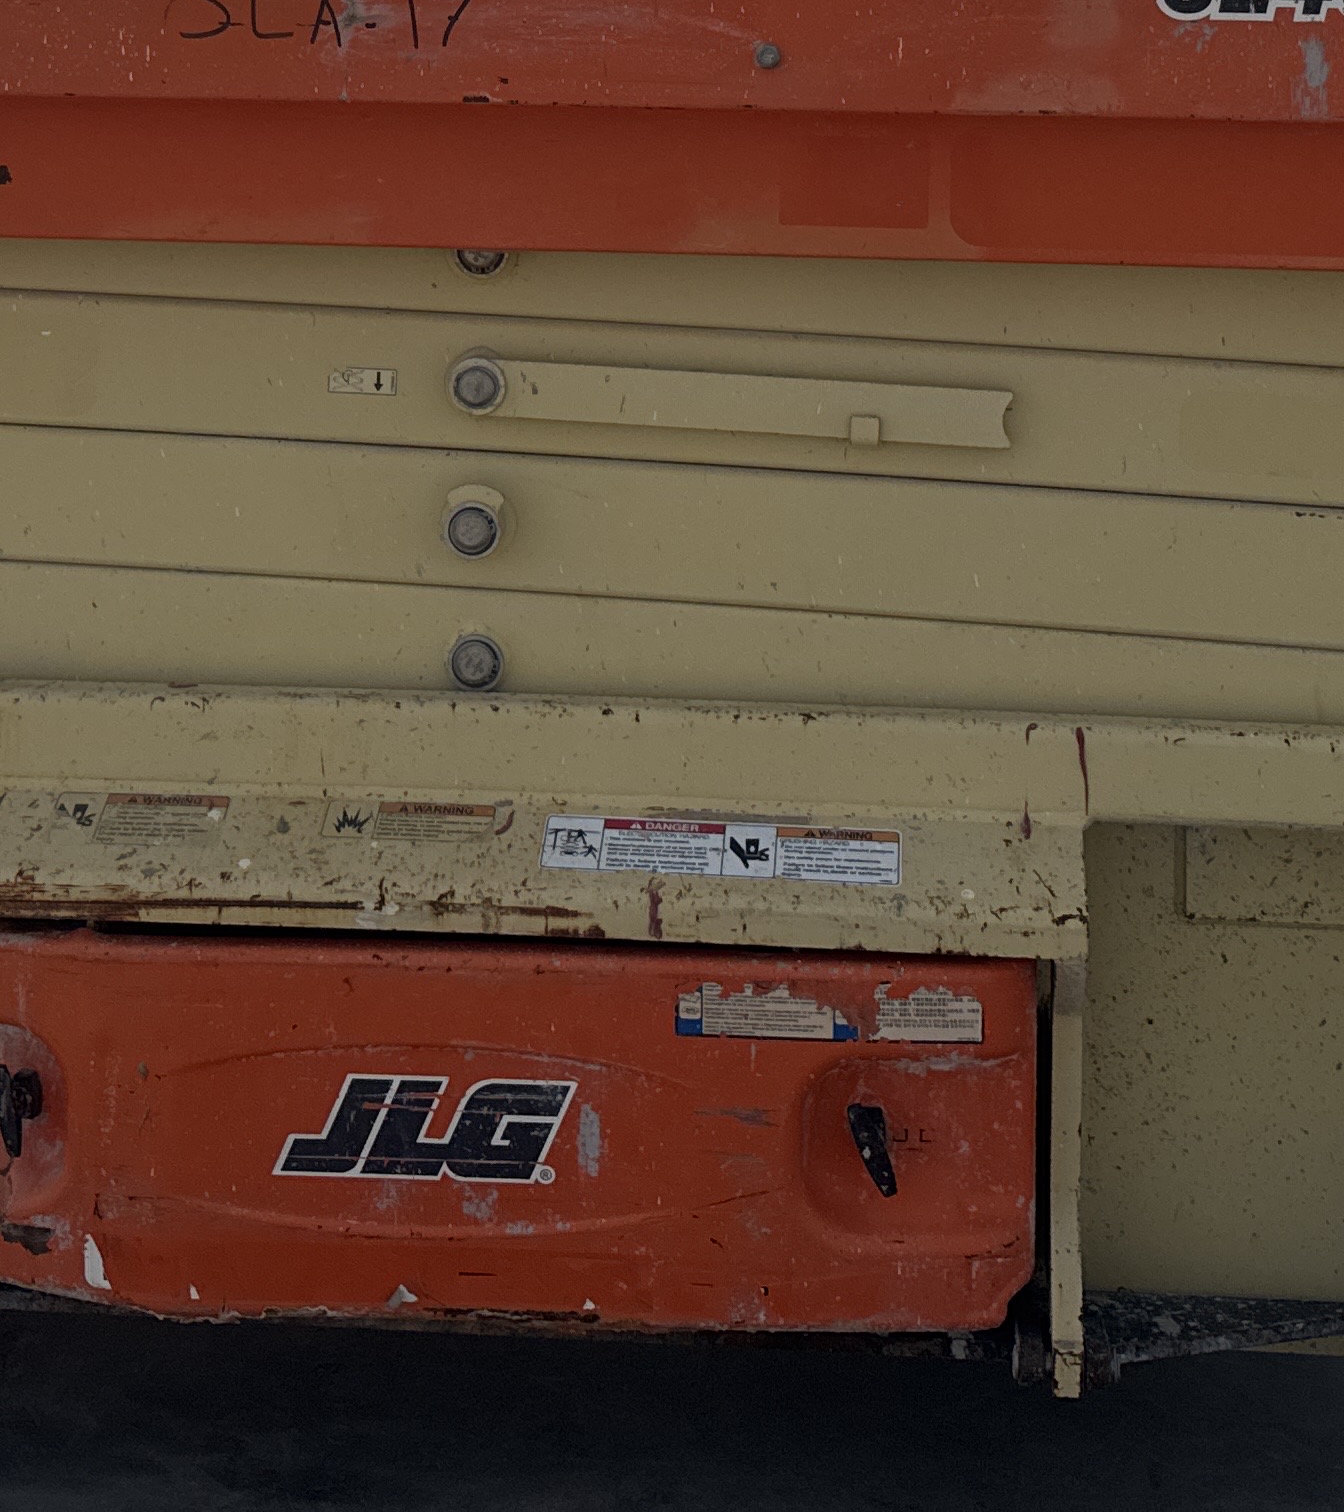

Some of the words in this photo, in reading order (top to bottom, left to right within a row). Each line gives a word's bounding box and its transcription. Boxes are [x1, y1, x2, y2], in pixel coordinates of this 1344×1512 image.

[143, 796, 203, 805] WARNING
[414, 805, 474, 815] WARNING
[645, 822, 700, 832] DANGER
[819, 829, 873, 840] WARNING
[272, 1074, 578, 1185] JLG
